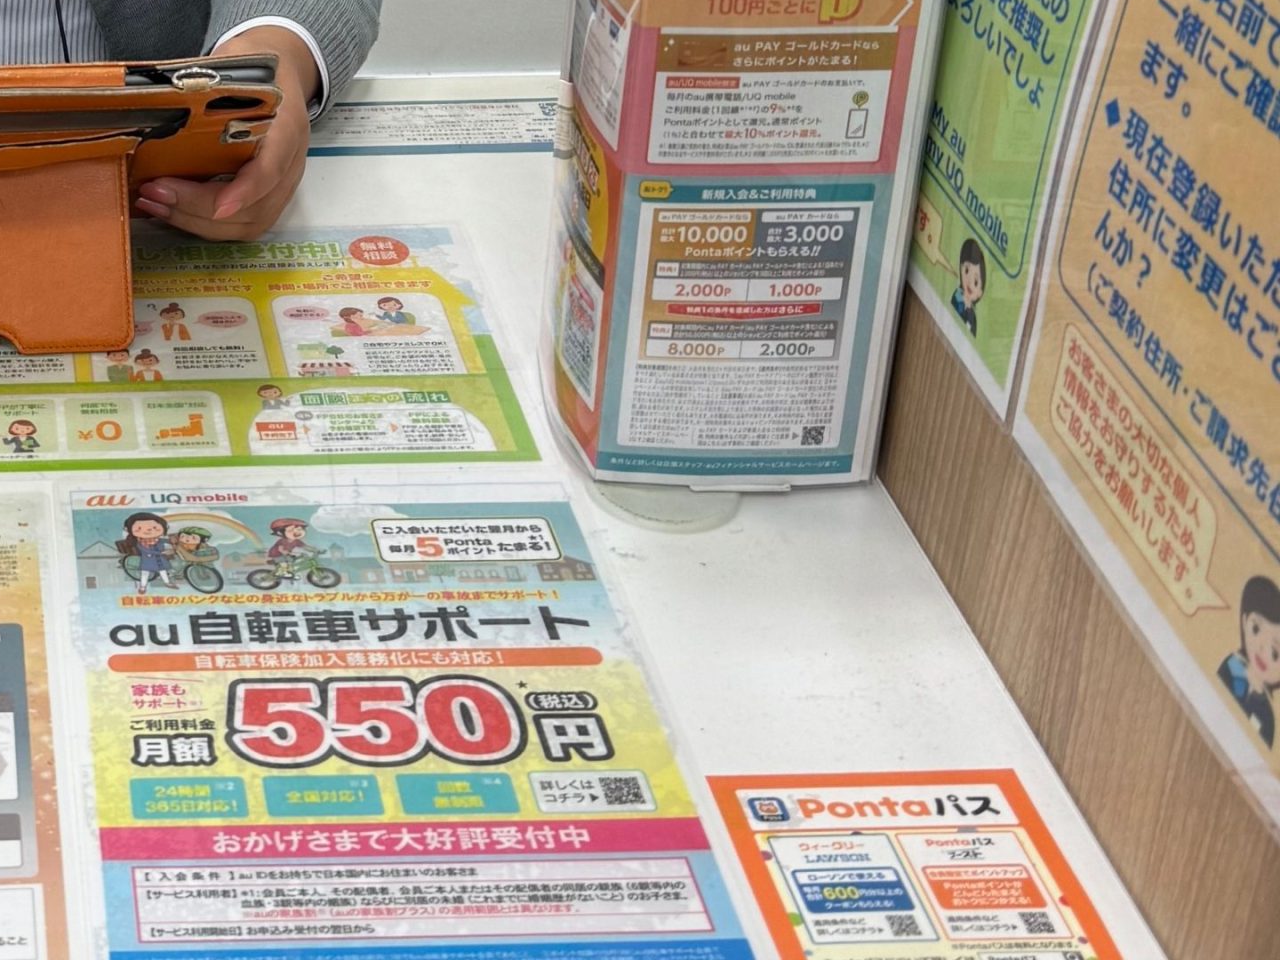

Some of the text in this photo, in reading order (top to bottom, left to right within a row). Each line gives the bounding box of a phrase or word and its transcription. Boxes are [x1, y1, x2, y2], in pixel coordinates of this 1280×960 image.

[755, 41, 781, 52] PAY
[1140, 39, 1192, 119] ます。
[965, 187, 1010, 248] mobile
[677, 224, 844, 244] 10,000 3,000
[86, 492, 249, 507] au UQ mobile
[109, 605, 590, 648] au 自転車サポート
[130, 718, 217, 731] ご利用料金
[131, 733, 218, 767] 月額
[225, 674, 528, 769] 550
[796, 794, 1001, 822] Pontaパス
[212, 825, 591, 853] おかげさまで大好評受付中
